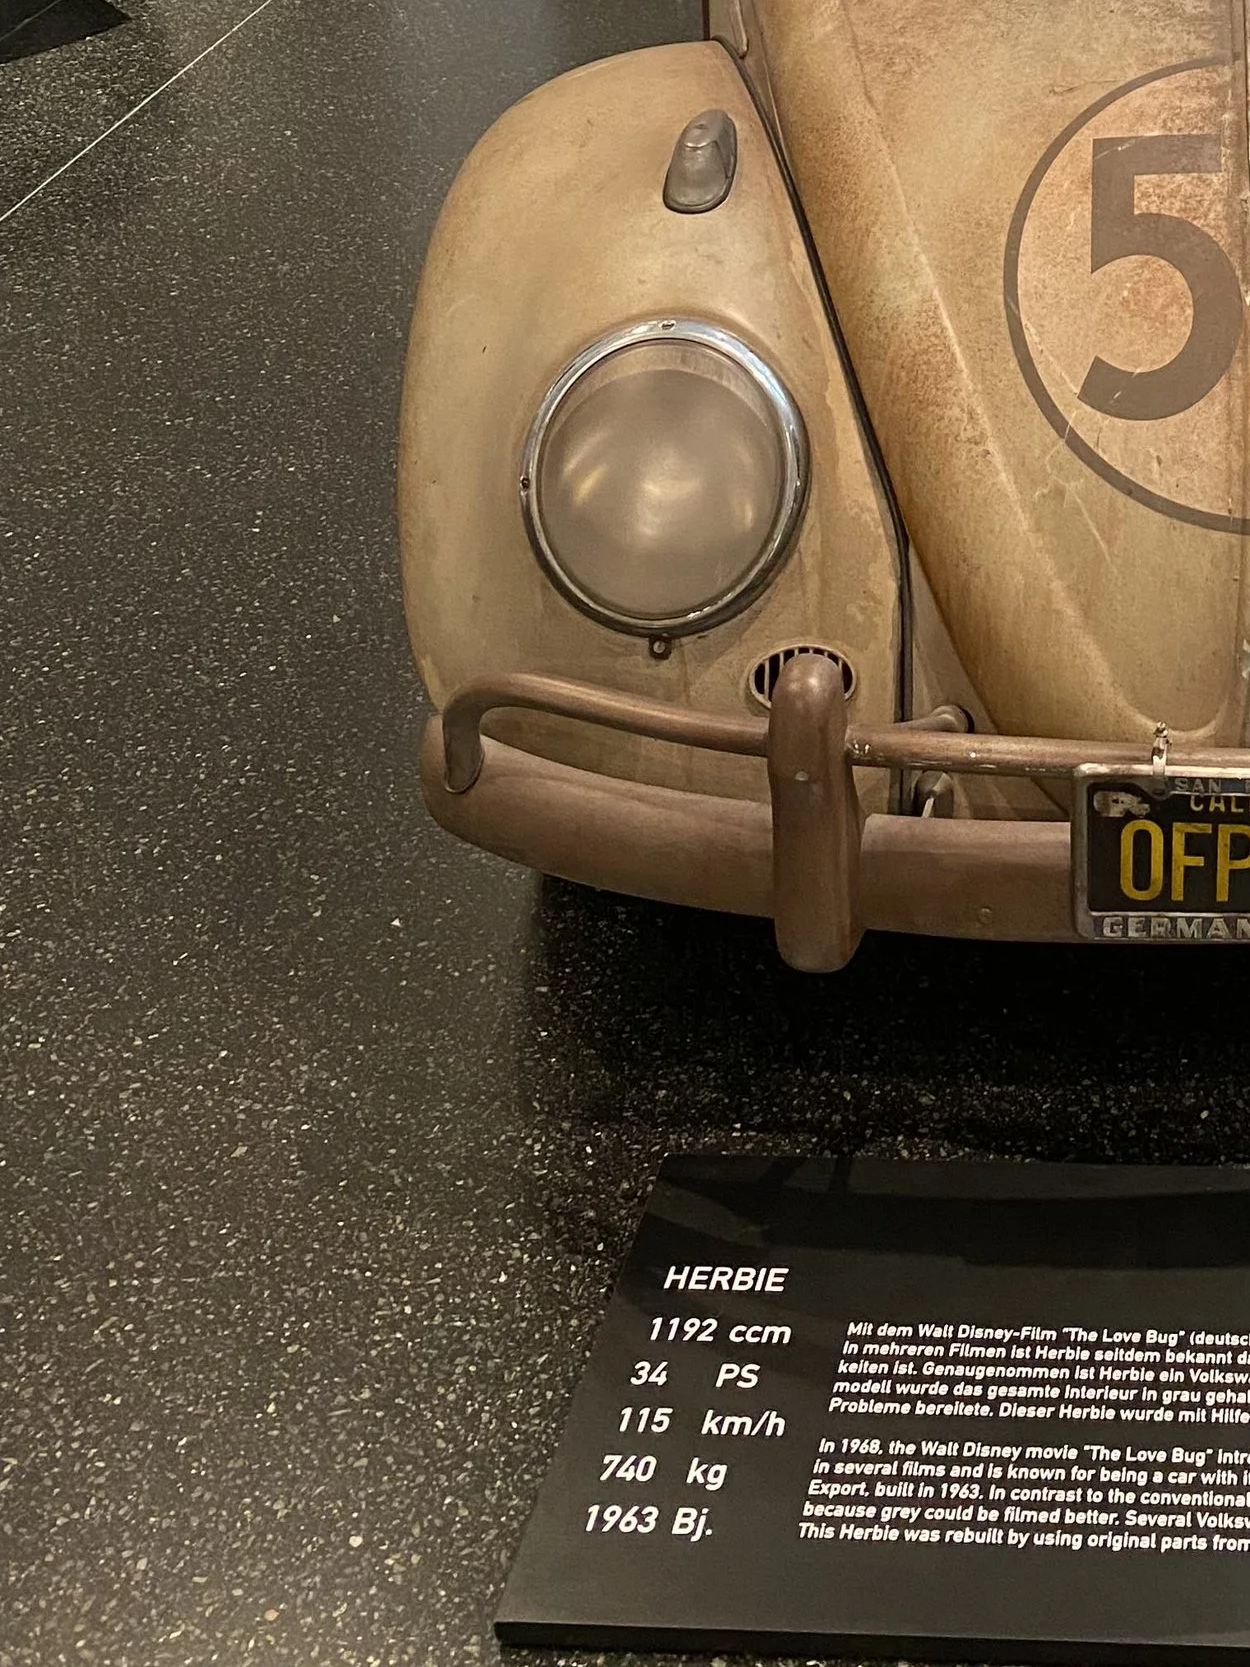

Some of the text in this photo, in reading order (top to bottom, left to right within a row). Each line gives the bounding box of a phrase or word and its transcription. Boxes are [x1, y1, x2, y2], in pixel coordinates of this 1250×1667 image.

[1174, 778, 1222, 793] SAN
[663, 1265, 790, 1292] HERBIE
[650, 1317, 792, 1344] 1192 ccm
[846, 1321, 874, 1336] Mit
[876, 1322, 914, 1337] dem
[918, 1323, 955, 1339] Walt
[957, 1324, 1058, 1343] Disney-Film
[1102, 1328, 1142, 1343] Love
[862, 1341, 945, 1357] mehreren
[948, 1342, 1007, 1359] Filmen
[1034, 1345, 1091, 1361] Herbie
[1094, 1347, 1161, 1363] seitdem
[1165, 1348, 1233, 1365] bekannt
[630, 1361, 761, 1388] 34 PS
[837, 1359, 889, 1375] keiten
[922, 1360, 1070, 1380] Genaugenommen
[1098, 1365, 1156, 1382] Herbie
[832, 1379, 893, 1394] modell
[895, 1380, 949, 1396] wurde
[986, 1384, 1061, 1400] gesamte
[1064, 1384, 1139, 1401] Interieur
[1161, 1390, 1202, 1405] grau
[619, 1407, 786, 1437] 115 km/h
[828, 1396, 912, 1415] Probleme
[998, 1402, 1056, 1419] Dieser
[1058, 1403, 1116, 1420] Herbie
[1119, 1406, 1174, 1422] wurde
[1177, 1407, 1207, 1423] mit
[1210, 1407, 1250, 1424] Hilfe
[888, 1439, 917, 1455] the
[921, 1440, 960, 1457] Walt
[962, 1441, 1023, 1462] Disney
[1025, 1444, 1079, 1460] movie
[1125, 1446, 1168, 1463] Love
[600, 1455, 728, 1491] 740 kg
[833, 1460, 899, 1476] several
[901, 1460, 946, 1477] films
[1006, 1463, 1066, 1481] known
[1099, 1466, 1148, 1487] being
[1200, 1468, 1238, 1486] with
[874, 1481, 915, 1498] built
[940, 1482, 984, 1500] 1963.
[1010, 1486, 1083, 1503] contrast
[1107, 1487, 1137, 1504] the
[585, 1504, 713, 1542] 1963 Bj.
[802, 1500, 877, 1519] because
[880, 1506, 922, 1524] grey
[923, 1504, 974, 1521] could
[1003, 1505, 1062, 1524] filmed
[1064, 1508, 1120, 1526] better.
[1124, 1509, 1193, 1528] Several
[798, 1522, 836, 1539] This
[838, 1523, 900, 1541] Herbie
[944, 1526, 1004, 1544] rebuilt
[1033, 1529, 1083, 1551] using
[1087, 1530, 1157, 1552] original
[1160, 1534, 1208, 1554] parts
